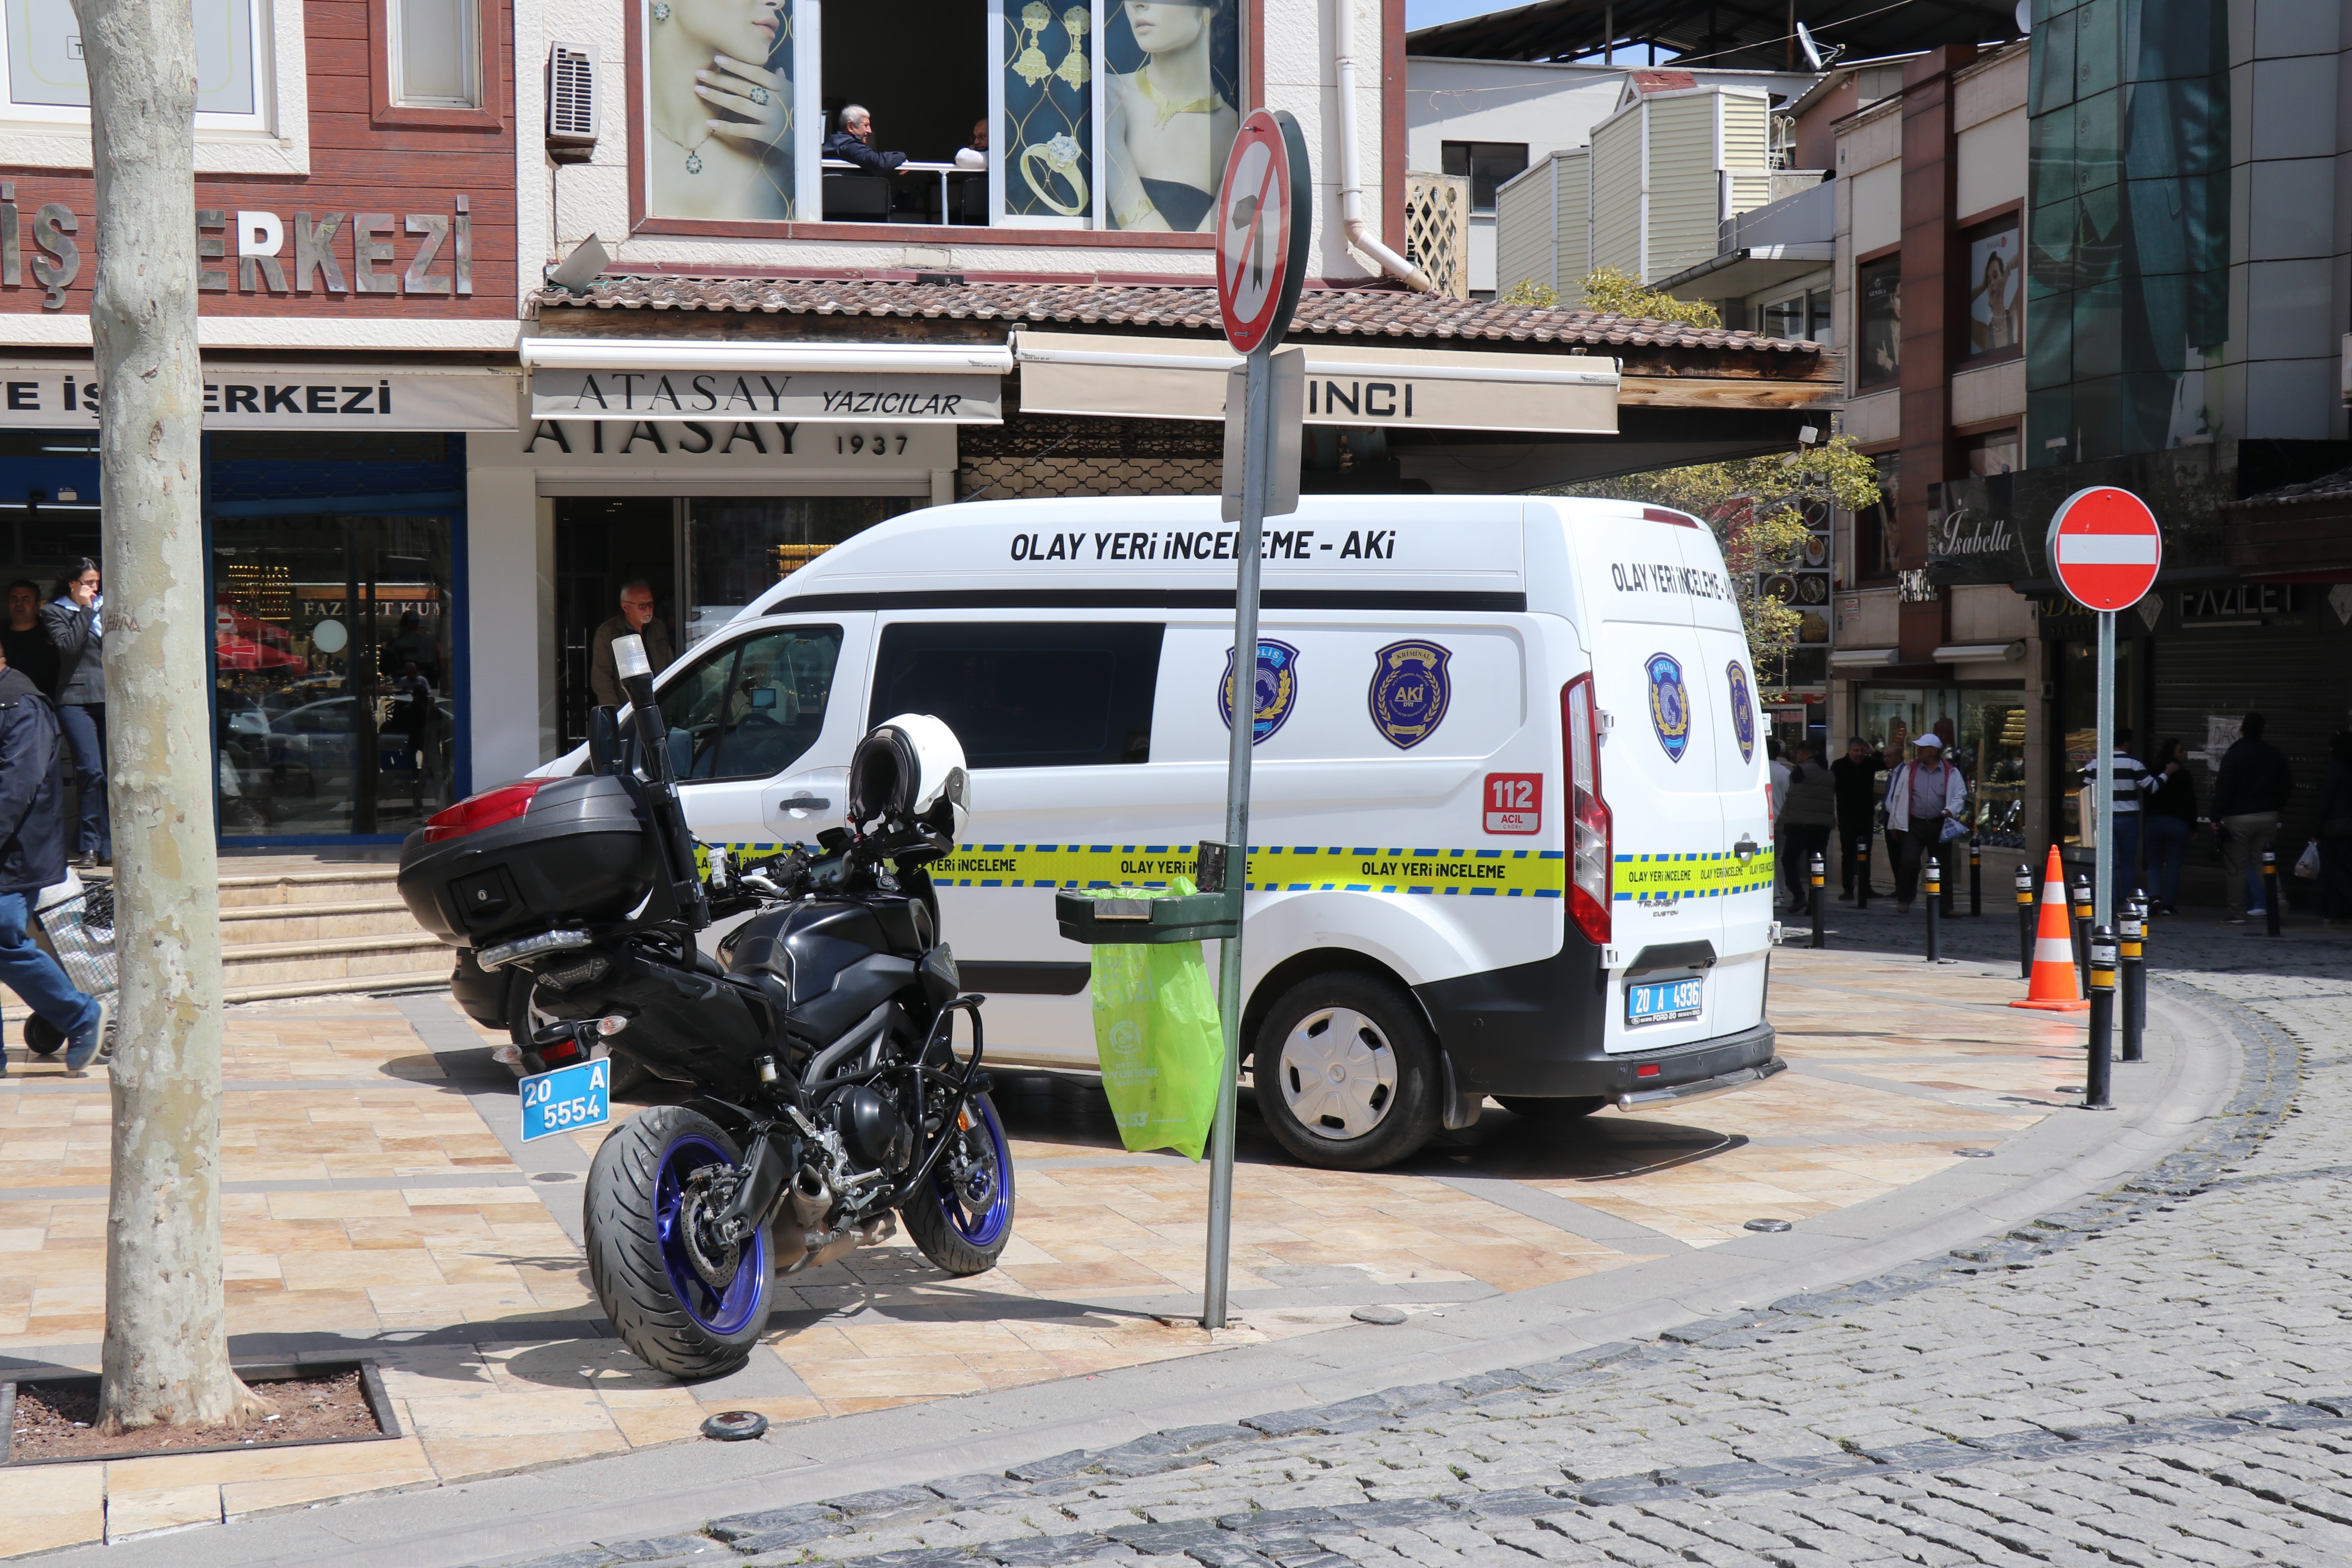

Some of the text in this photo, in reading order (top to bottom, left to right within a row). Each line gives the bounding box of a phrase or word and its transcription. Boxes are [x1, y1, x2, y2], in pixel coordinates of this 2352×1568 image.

[196, 195, 473, 294] ERKEZİ
[1869, 288, 1887, 297] GENOLA
[203, 380, 392, 415] ERKEZİ
[573, 373, 962, 416] ATASAY YAZICILAR
[524, 420, 909, 456] ATASAY 1937
[1010, 533, 1087, 561] OLAY
[1612, 563, 1648, 592] OLAY
[1396, 650, 1430, 660] KRİMİNAL
[1394, 684, 1424, 701] AKİ
[1493, 780, 1533, 808] 112
[1121, 860, 1155, 874] OLAY
[1362, 862, 1399, 876] OLAY
[1629, 871, 1649, 882] OLAY
[1700, 869, 1712, 880] OLAY
[1637, 899, 1680, 909] TRANSIT
[1635, 981, 1700, 1014] 20 A 4936
[1652, 1014, 1668, 1022] FORD
[525, 1066, 604, 1109] 20 A
[544, 1094, 600, 1129] 5554
[1128, 1112, 1148, 1127] 153
